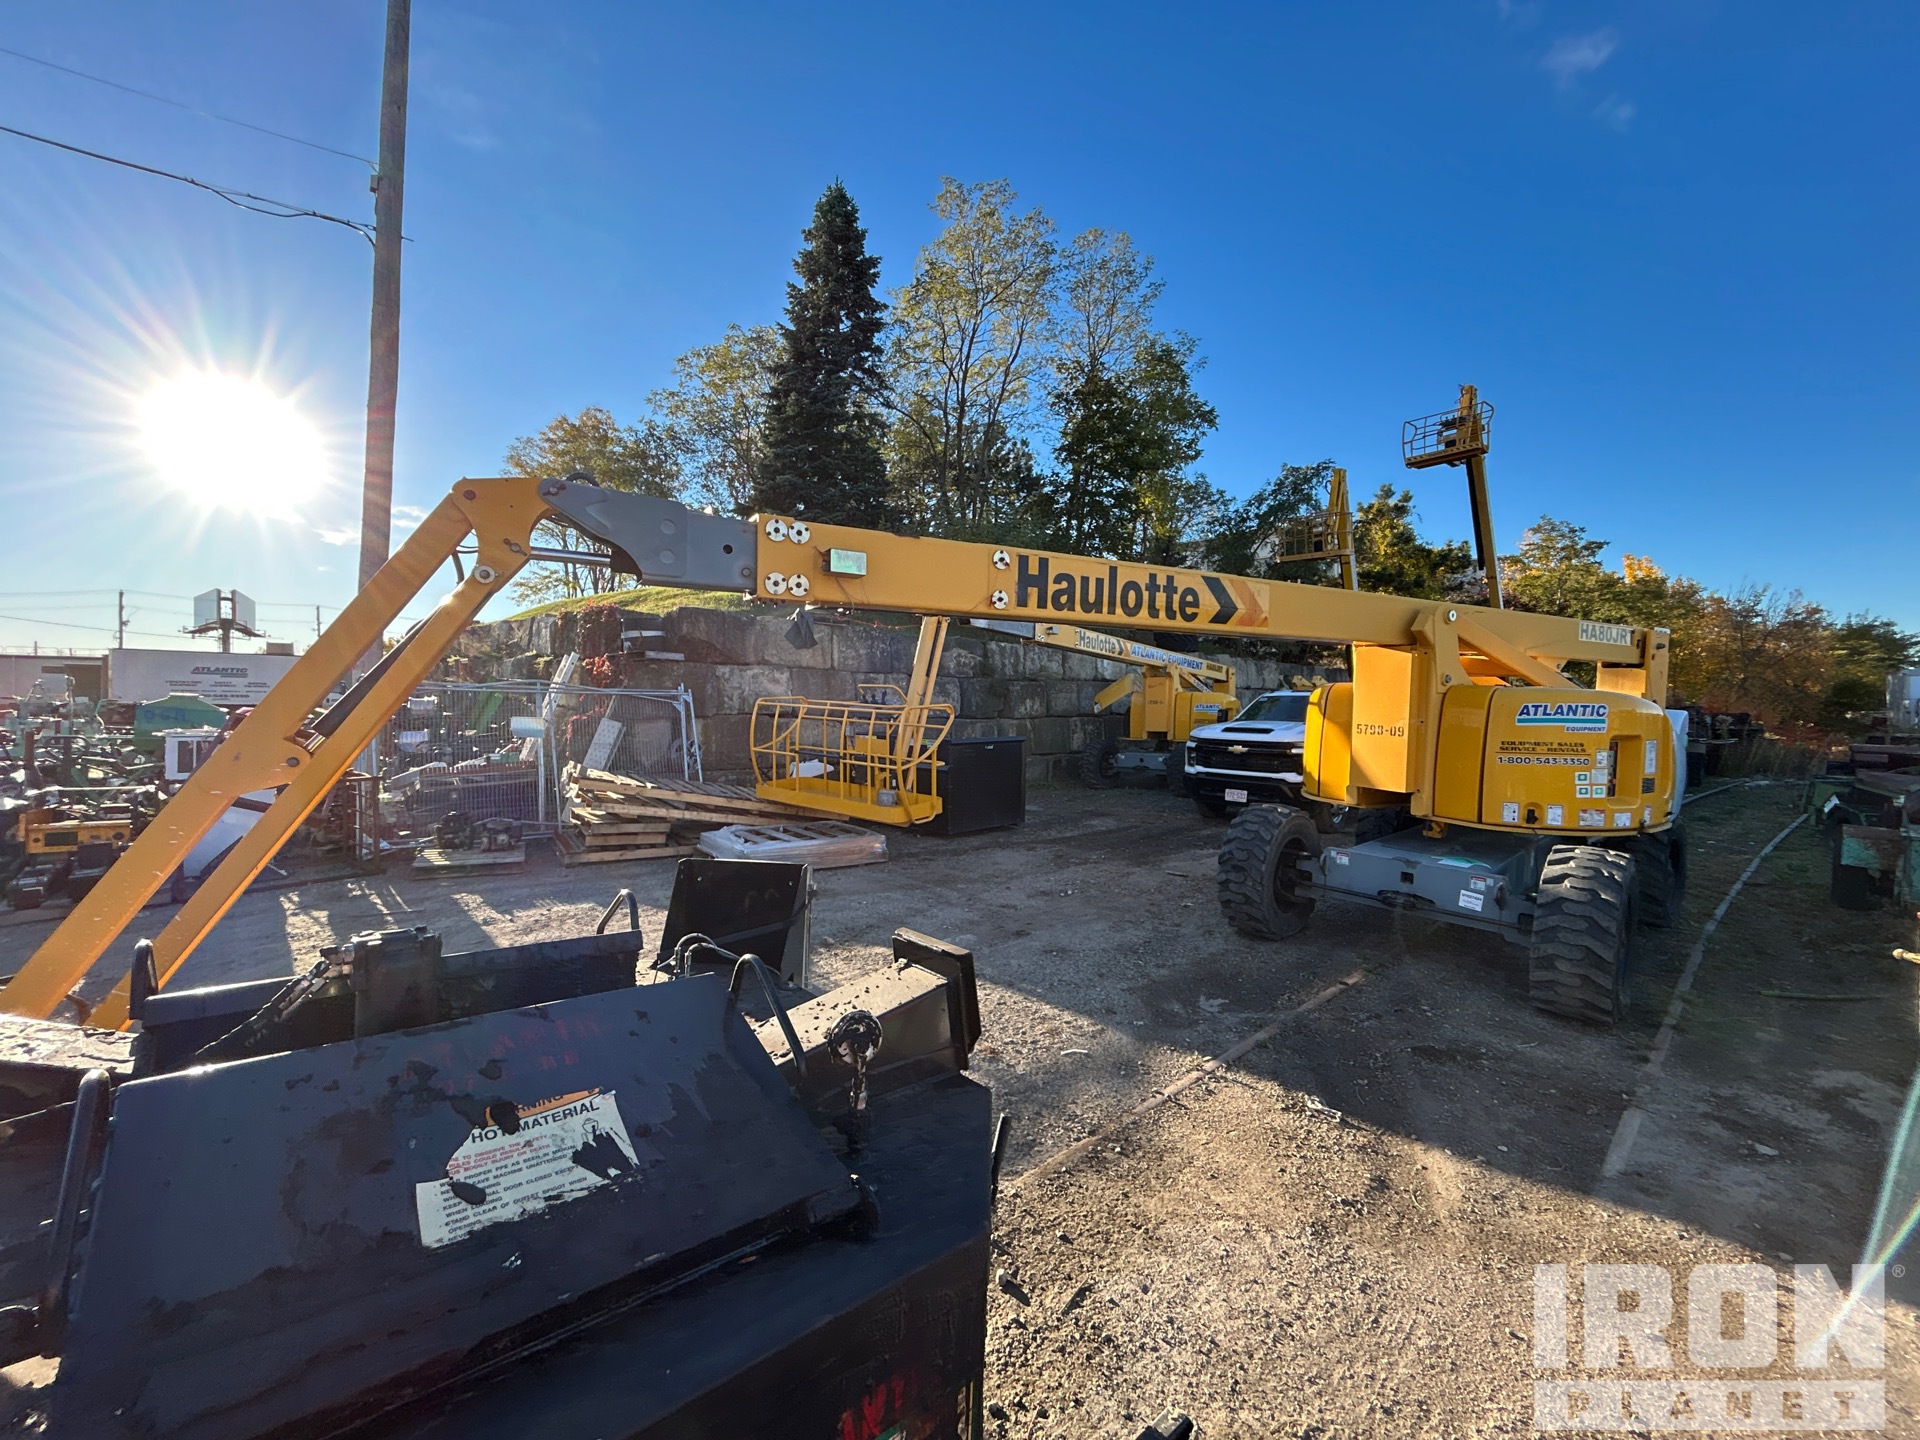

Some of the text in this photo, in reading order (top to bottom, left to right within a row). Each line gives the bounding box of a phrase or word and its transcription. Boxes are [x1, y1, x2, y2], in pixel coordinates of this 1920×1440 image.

[1016, 555, 1200, 622] Haulotte
[1079, 631, 1116, 655] Haulotte
[1131, 645, 1166, 662] ATLANTIC
[1168, 654, 1203, 671] EQUIPMENT
[1517, 704, 1607, 718] ATLANTIC
[1497, 756, 1590, 766] 1-800-543-3350
[471, 1100, 600, 1144] HOT MATERIAL
[525, 1153, 568, 1170] UNATTENDED
[463, 1168, 493, 1180] PROPER
[442, 1200, 463, 1211] KEEP
[503, 1181, 524, 1192] DOOR
[525, 1172, 553, 1185] CLOSED
[472, 1205, 498, 1217] CLEAR
[568, 1176, 588, 1186] WHEN
[445, 1207, 468, 1218] WHEN
[448, 1230, 471, 1242] NEVE
